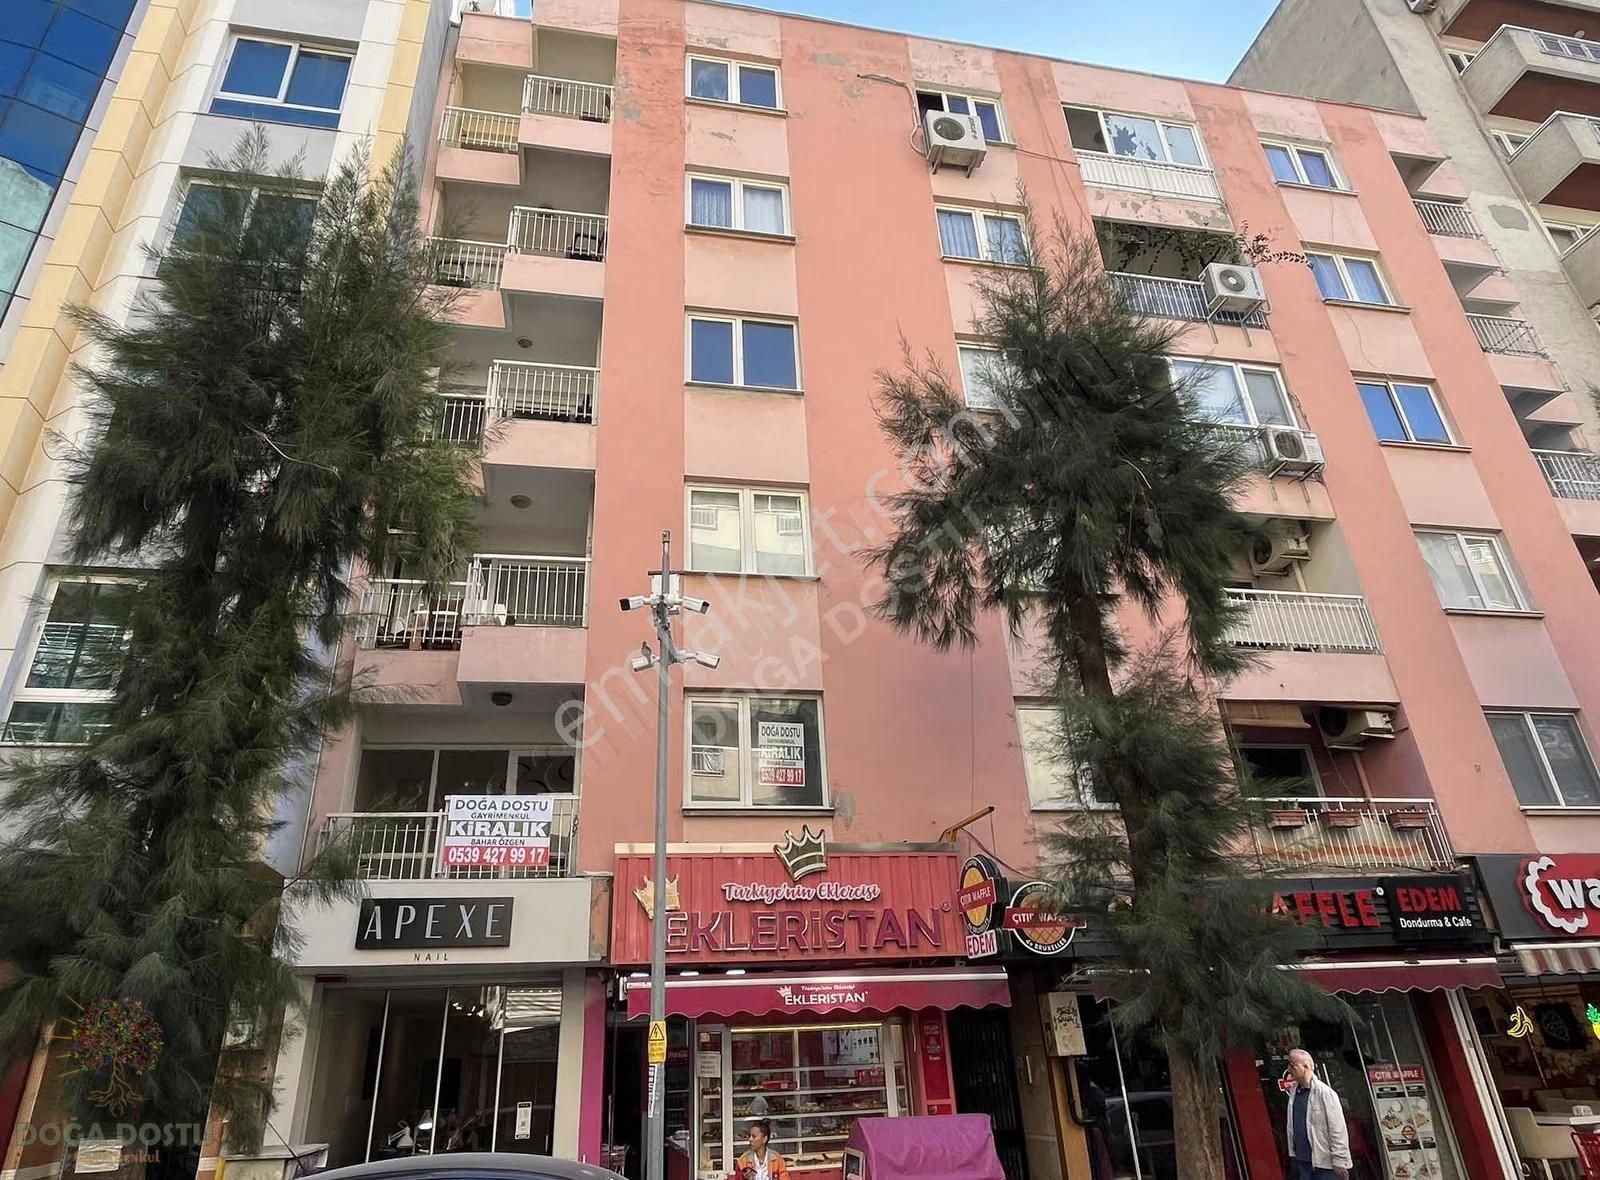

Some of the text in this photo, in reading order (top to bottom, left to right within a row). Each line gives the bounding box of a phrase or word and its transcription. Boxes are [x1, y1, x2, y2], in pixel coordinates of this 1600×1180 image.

[455, 797, 548, 811] DOĞA DOSTU
[471, 837, 525, 846] BAHAR ÖZGEN
[448, 847, 545, 863] 0539 427 99 17
[971, 886, 992, 900] WAFFLE
[1396, 887, 1463, 912] EDEM
[1258, 889, 1380, 928] AFFLE
[364, 904, 505, 940] APEXE
[1400, 916, 1472, 928] Dondurma & Cafe
[967, 932, 995, 957] EDEM
[413, 953, 448, 961] NAIL
